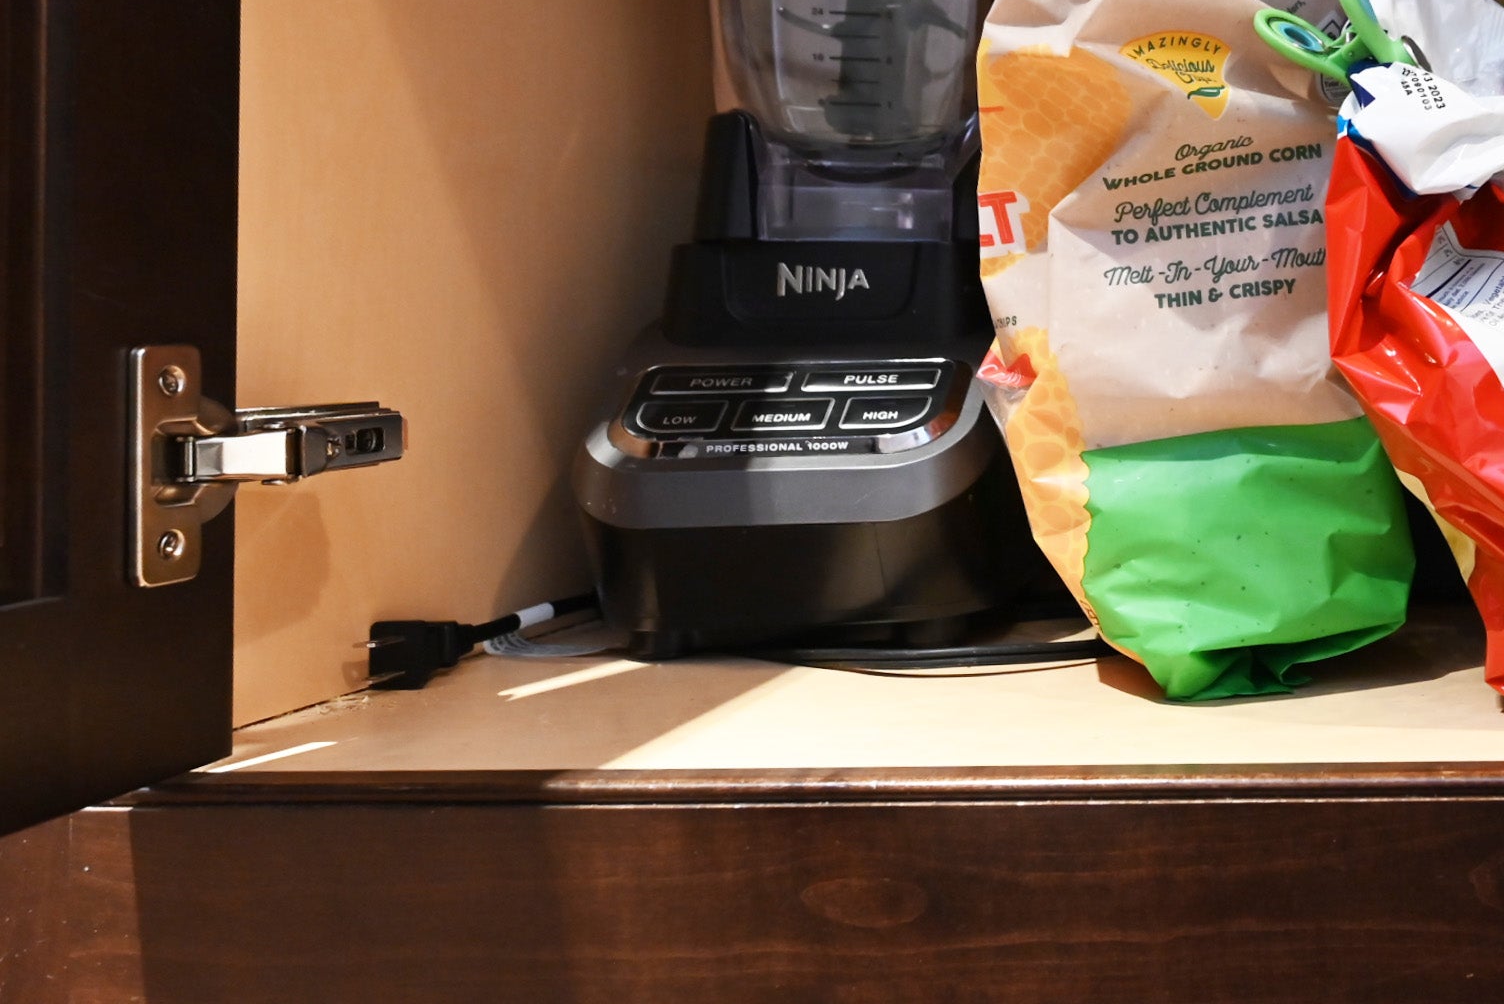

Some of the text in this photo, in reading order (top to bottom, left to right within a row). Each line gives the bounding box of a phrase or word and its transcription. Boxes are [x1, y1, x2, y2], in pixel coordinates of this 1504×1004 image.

[1428, 85, 1446, 109] 2023
[1174, 135, 1254, 162] Organic
[1102, 143, 1323, 191] WHOLE GROUND CORN
[1114, 184, 1314, 227] Perfect Complement
[1111, 208, 1323, 245] TO AUTHENTIC SALSA
[777, 261, 870, 301] NINJA
[1154, 278, 1296, 309] THIN & CRISPY
[689, 373, 898, 389] POWER PULSE
[662, 409, 899, 426] LOW MEDIUM HIGH
[705, 439, 850, 454] PROFESSIONAL 1000W
